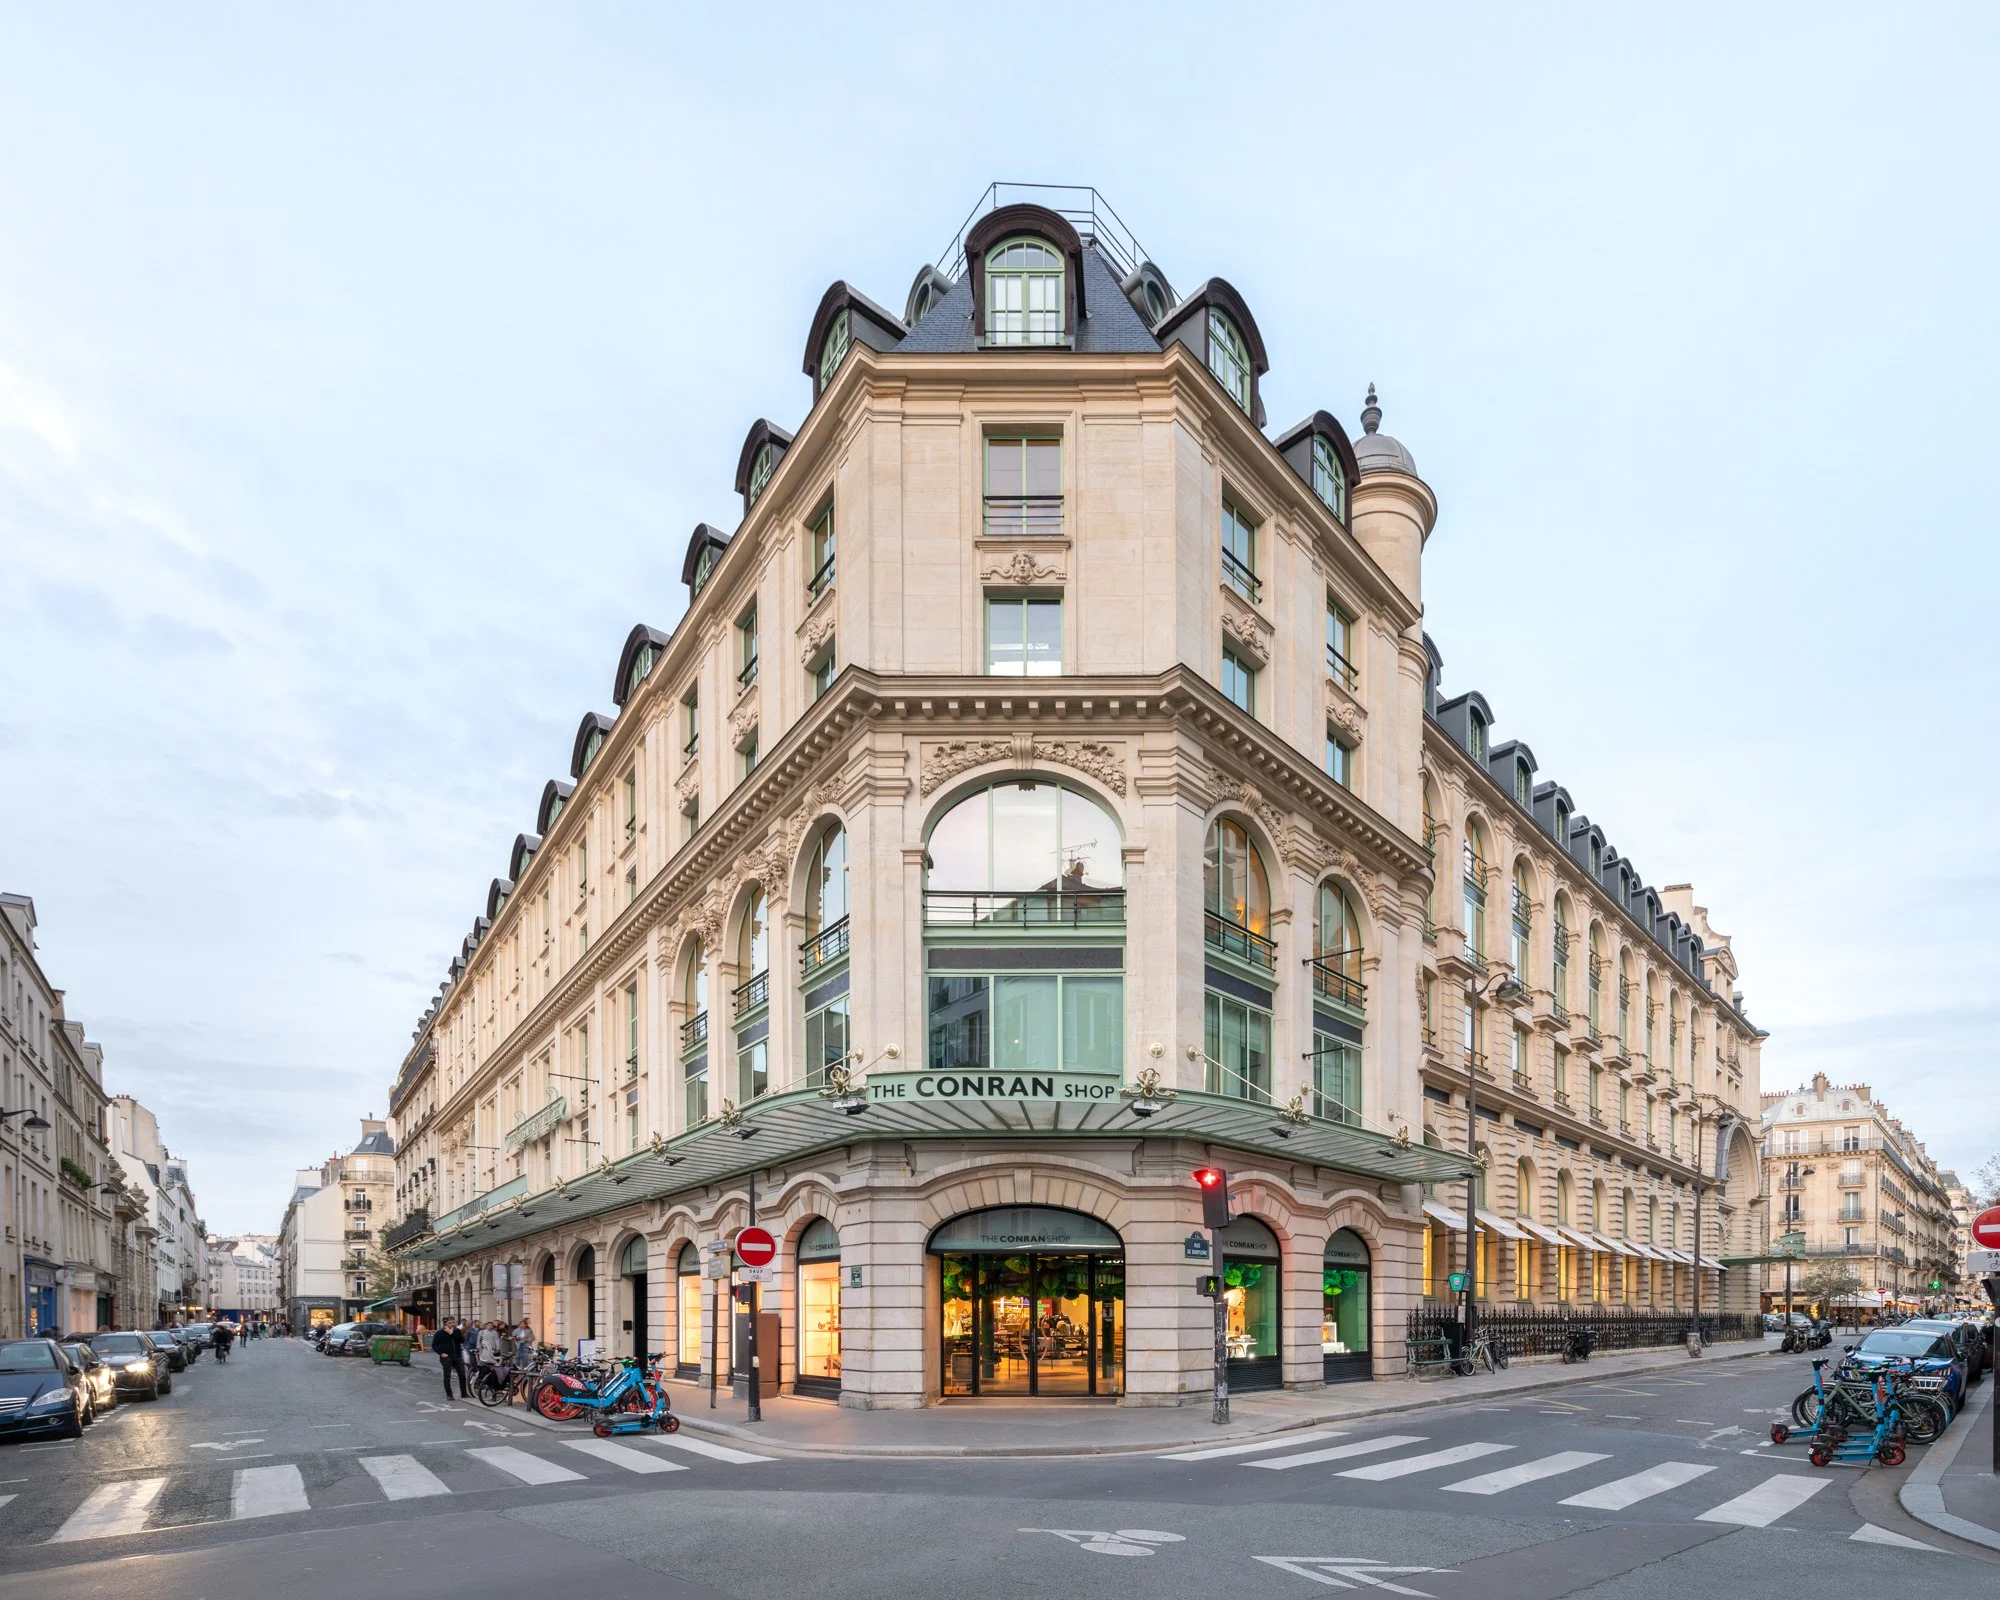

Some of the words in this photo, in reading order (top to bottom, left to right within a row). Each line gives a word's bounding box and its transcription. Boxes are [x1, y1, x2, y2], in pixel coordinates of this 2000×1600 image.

[871, 1084, 905, 1098] THE
[915, 1077, 1053, 1097] CONRAN
[1064, 1084, 1115, 1099] SHOP
[982, 1235, 998, 1243] THE
[1000, 1235, 1045, 1243] CONRAN
[1046, 1235, 1070, 1243] SHOP
[1229, 1241, 1254, 1249] CONRAN
[613, 1384, 627, 1398] dott
